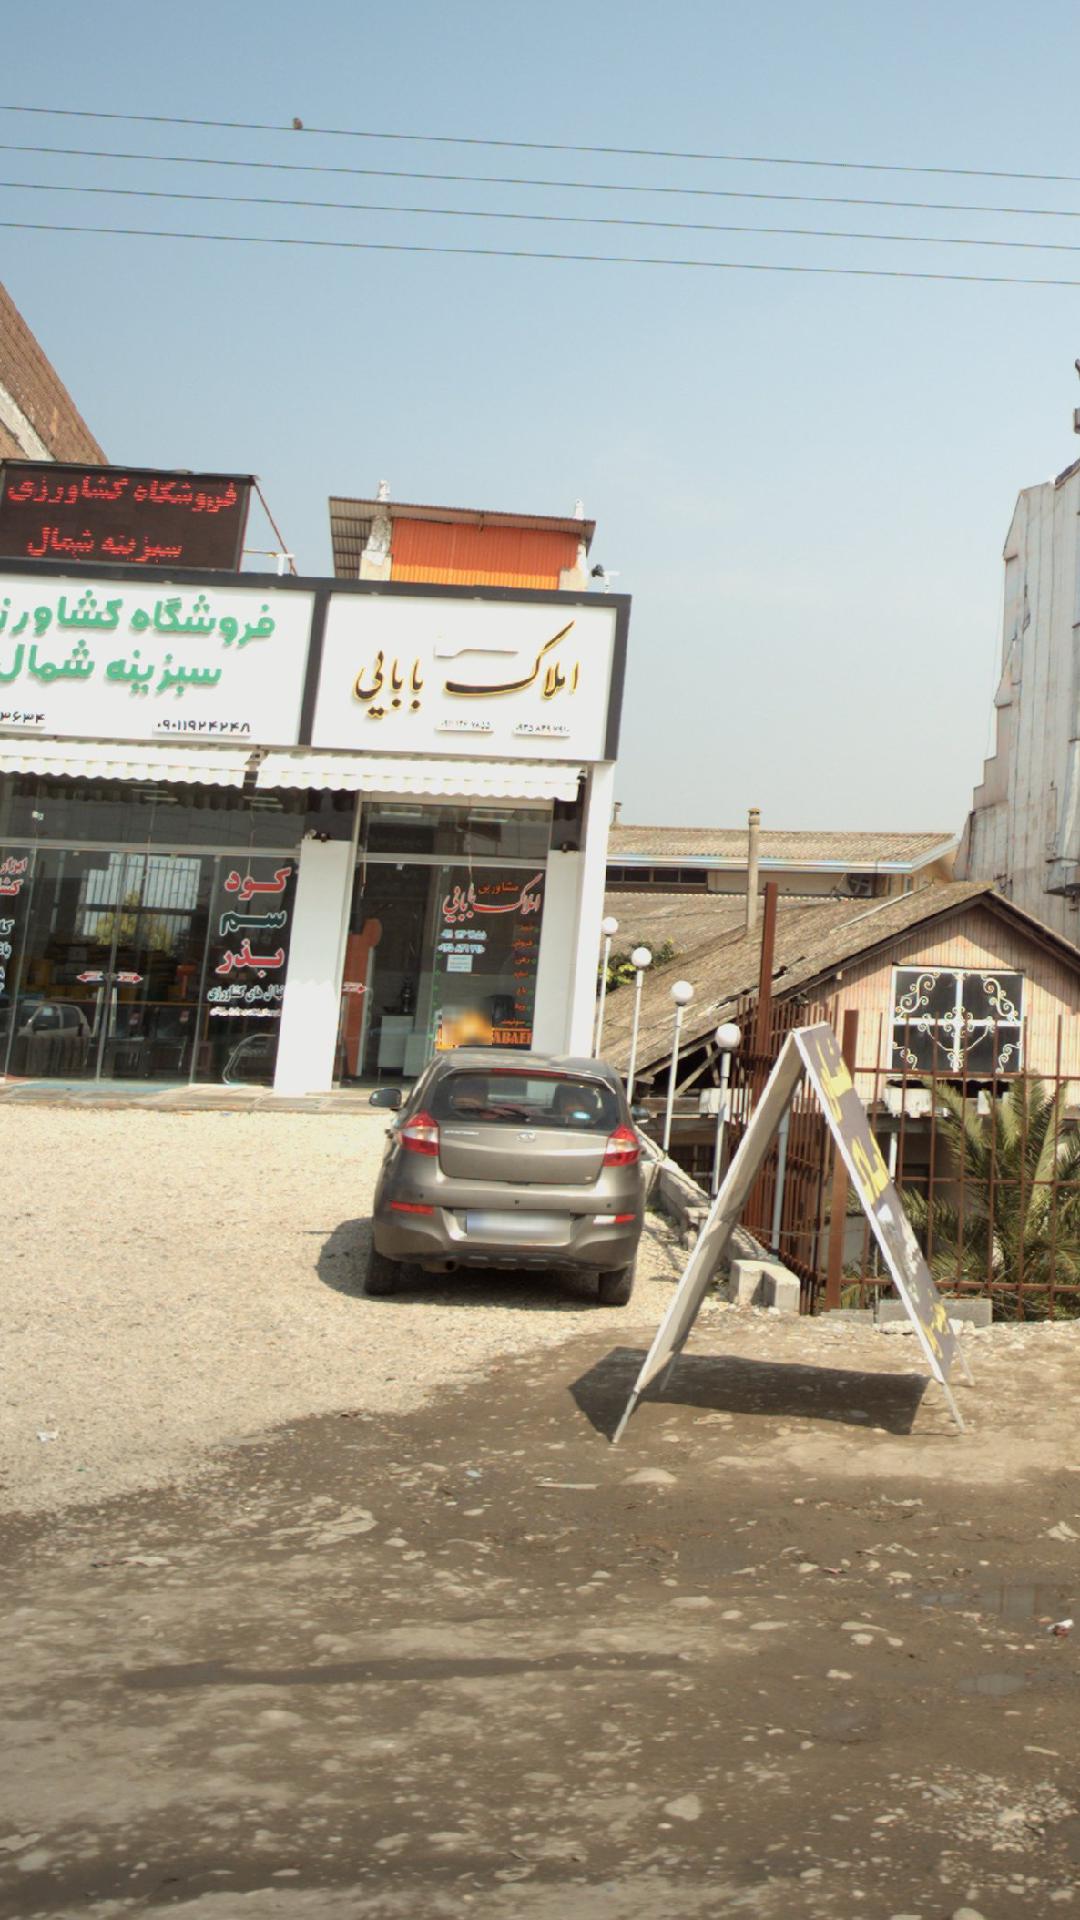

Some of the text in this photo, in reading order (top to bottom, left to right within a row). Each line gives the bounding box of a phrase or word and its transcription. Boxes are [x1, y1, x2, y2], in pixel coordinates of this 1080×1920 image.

[8, 475, 237, 513] فروشگاه کشاورزی
[26, 526, 183, 563] سبزینه شمال
[0, 589, 276, 645] فروشگاه کشاورز
[0, 638, 222, 694] سبزینه شمال
[444, 619, 580, 700] املاک
[225, 866, 292, 900] کود
[219, 911, 286, 936] سم
[215, 938, 284, 978] بذر
